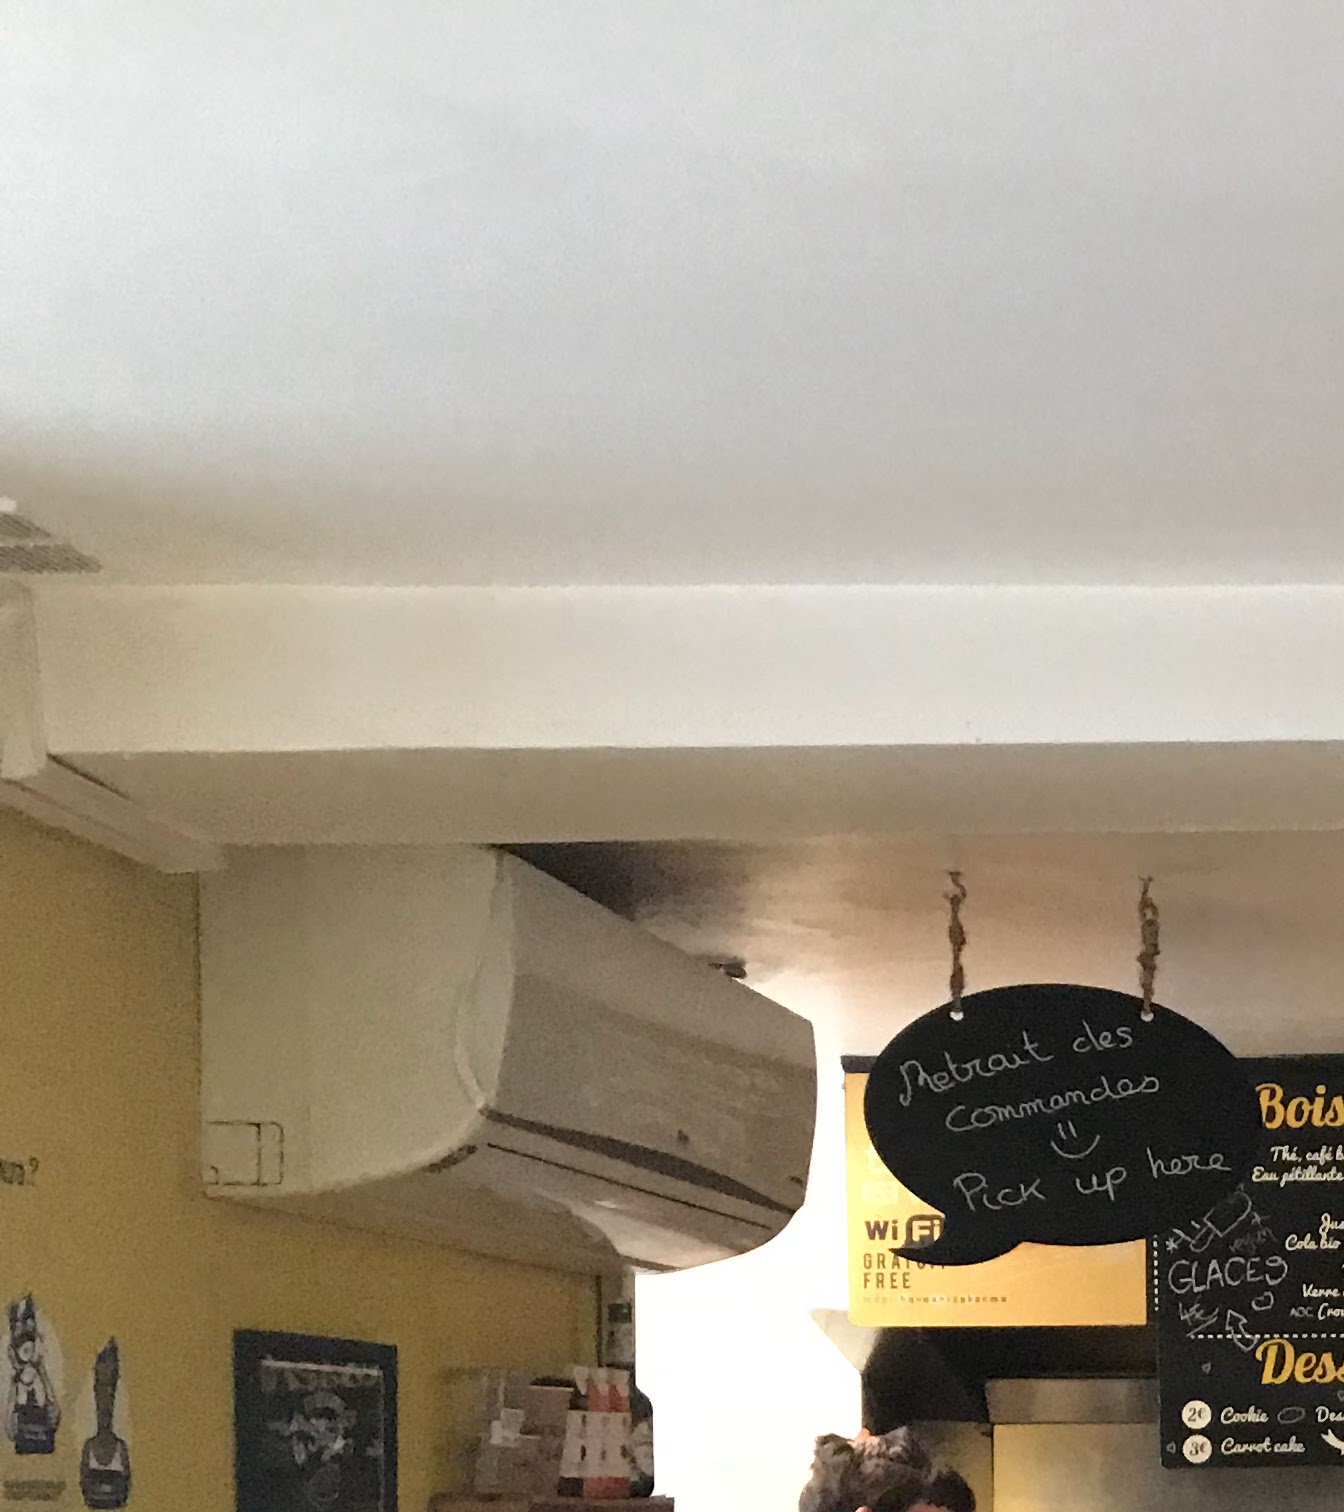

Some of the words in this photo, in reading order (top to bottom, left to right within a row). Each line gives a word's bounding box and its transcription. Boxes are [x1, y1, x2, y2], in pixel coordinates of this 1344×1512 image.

[900, 1030, 1054, 1107] Retrait
[1072, 1019, 1134, 1054] des
[1306, 1145, 1333, 1165] café
[1075, 1166, 1128, 1200] up
[1147, 1147, 1232, 1179] here
[1252, 1166, 1279, 1182] Eau
[1280, 1165, 1344, 1188] pétillante
[1285, 1233, 1318, 1250] Cola
[1320, 1233, 1341, 1249] bio
[863, 1272, 912, 1289] FREE
[1168, 1255, 1288, 1294] GLACES
[1303, 1283, 1340, 1298] Verre
[1220, 1407, 1269, 1425] Cookie
[1220, 1437, 1271, 1455] Carrot
[1273, 1438, 1305, 1454] cake
